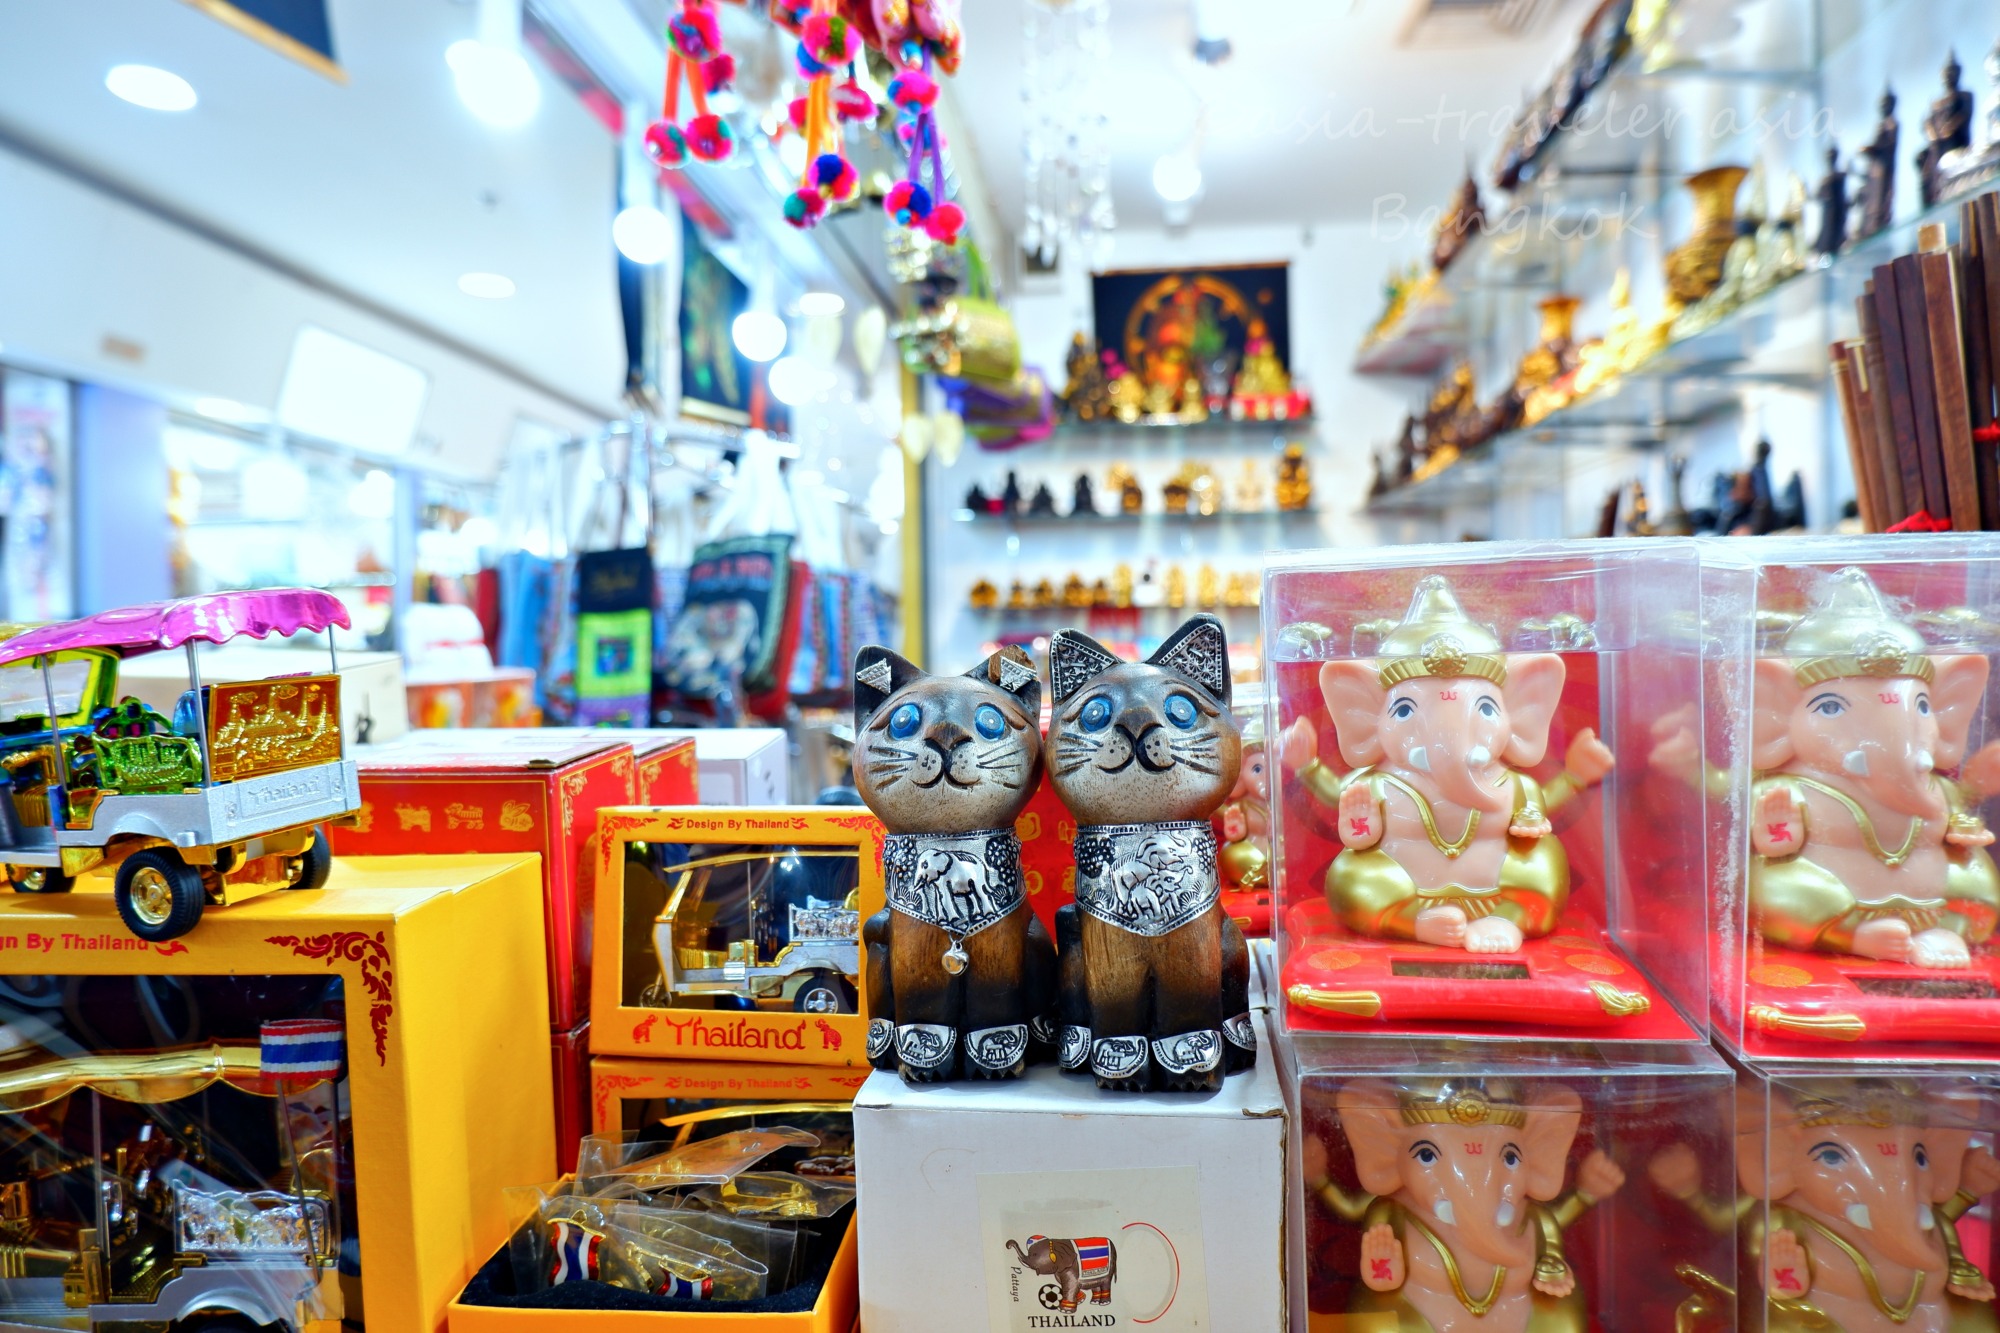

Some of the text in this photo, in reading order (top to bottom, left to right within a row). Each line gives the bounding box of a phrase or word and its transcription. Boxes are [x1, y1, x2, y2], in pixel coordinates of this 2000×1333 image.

[247, 775, 321, 805] Thailand
[686, 819, 790, 831] Design By Thailand
[27, 933, 54, 953] By
[61, 934, 148, 950] Thailand
[666, 1016, 806, 1050] Thailand
[684, 1078, 792, 1090] Design By Thailand
[1010, 1266, 1022, 1303] Pattaya
[1028, 1314, 1116, 1328] THAILAND
